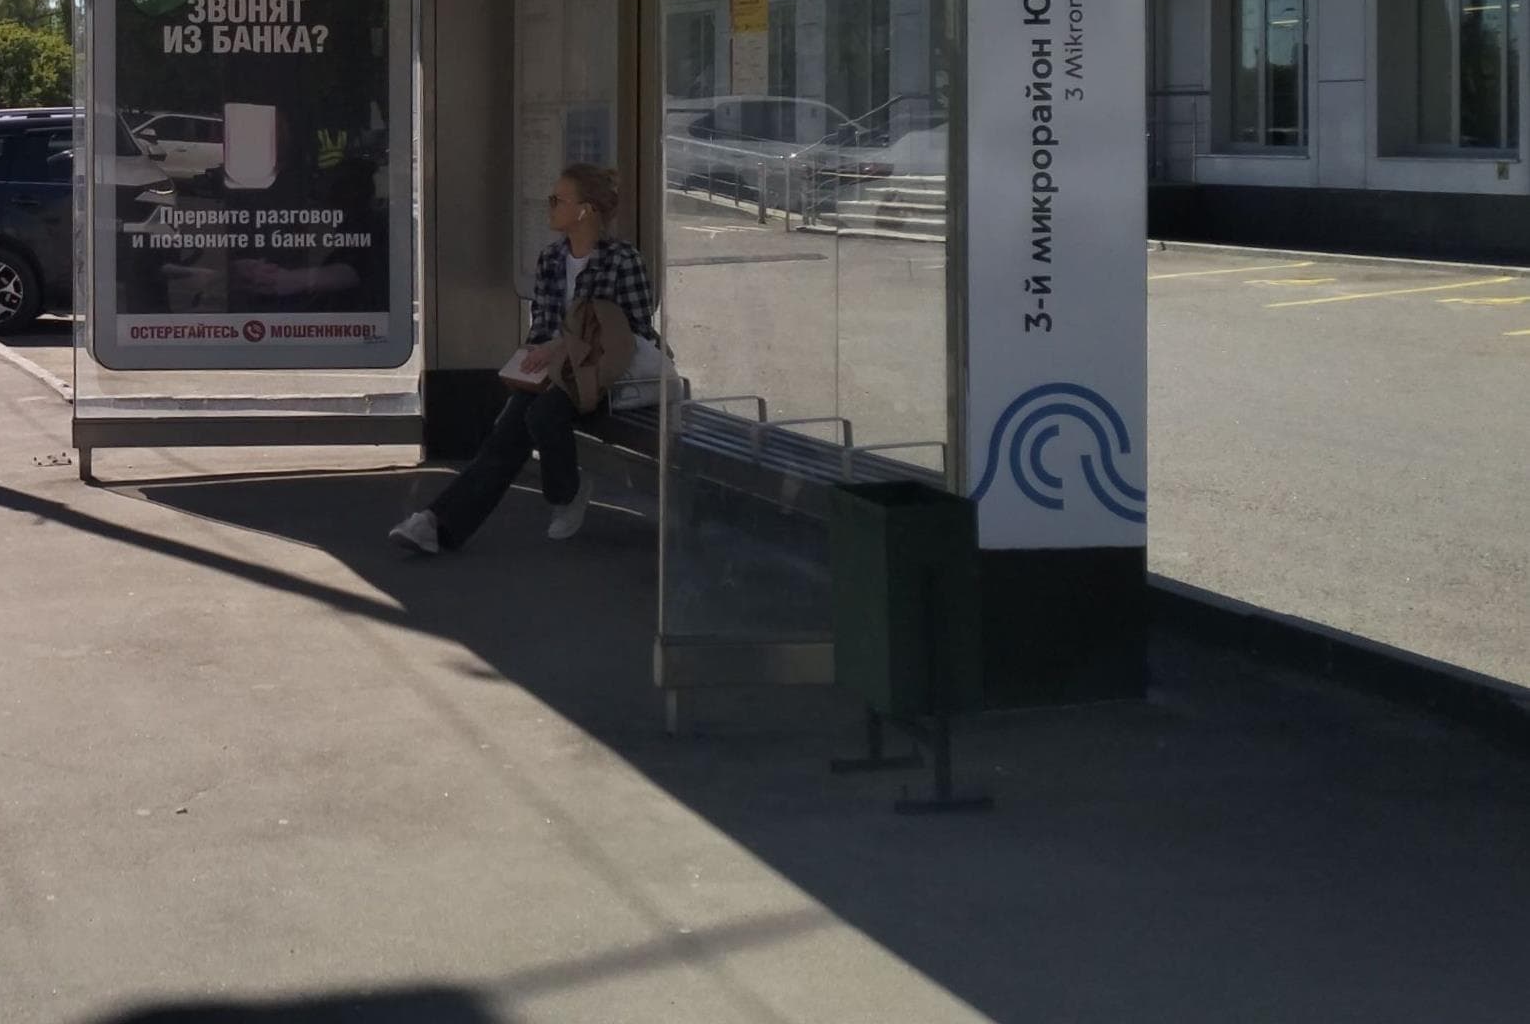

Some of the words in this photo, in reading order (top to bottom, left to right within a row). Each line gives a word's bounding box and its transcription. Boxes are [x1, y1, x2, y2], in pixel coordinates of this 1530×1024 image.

[163, 25, 202, 54] ИЗ
[212, 24, 329, 54] БАНКА?
[1065, 86, 1085, 101] 3
[1024, 38, 1059, 264] микрорайон
[160, 206, 250, 228] Прервите
[255, 208, 344, 228] разговор
[131, 233, 144, 249] и
[150, 232, 249, 249] позвоните
[254, 233, 266, 248] в
[271, 230, 317, 248] банк
[322, 232, 372, 248] сами
[1024, 275, 1052, 334] 3-й
[130, 323, 239, 340] ОСТЕРЕГАЙТЕСЬ
[270, 323, 377, 339] МОШЕННИКОВ!
